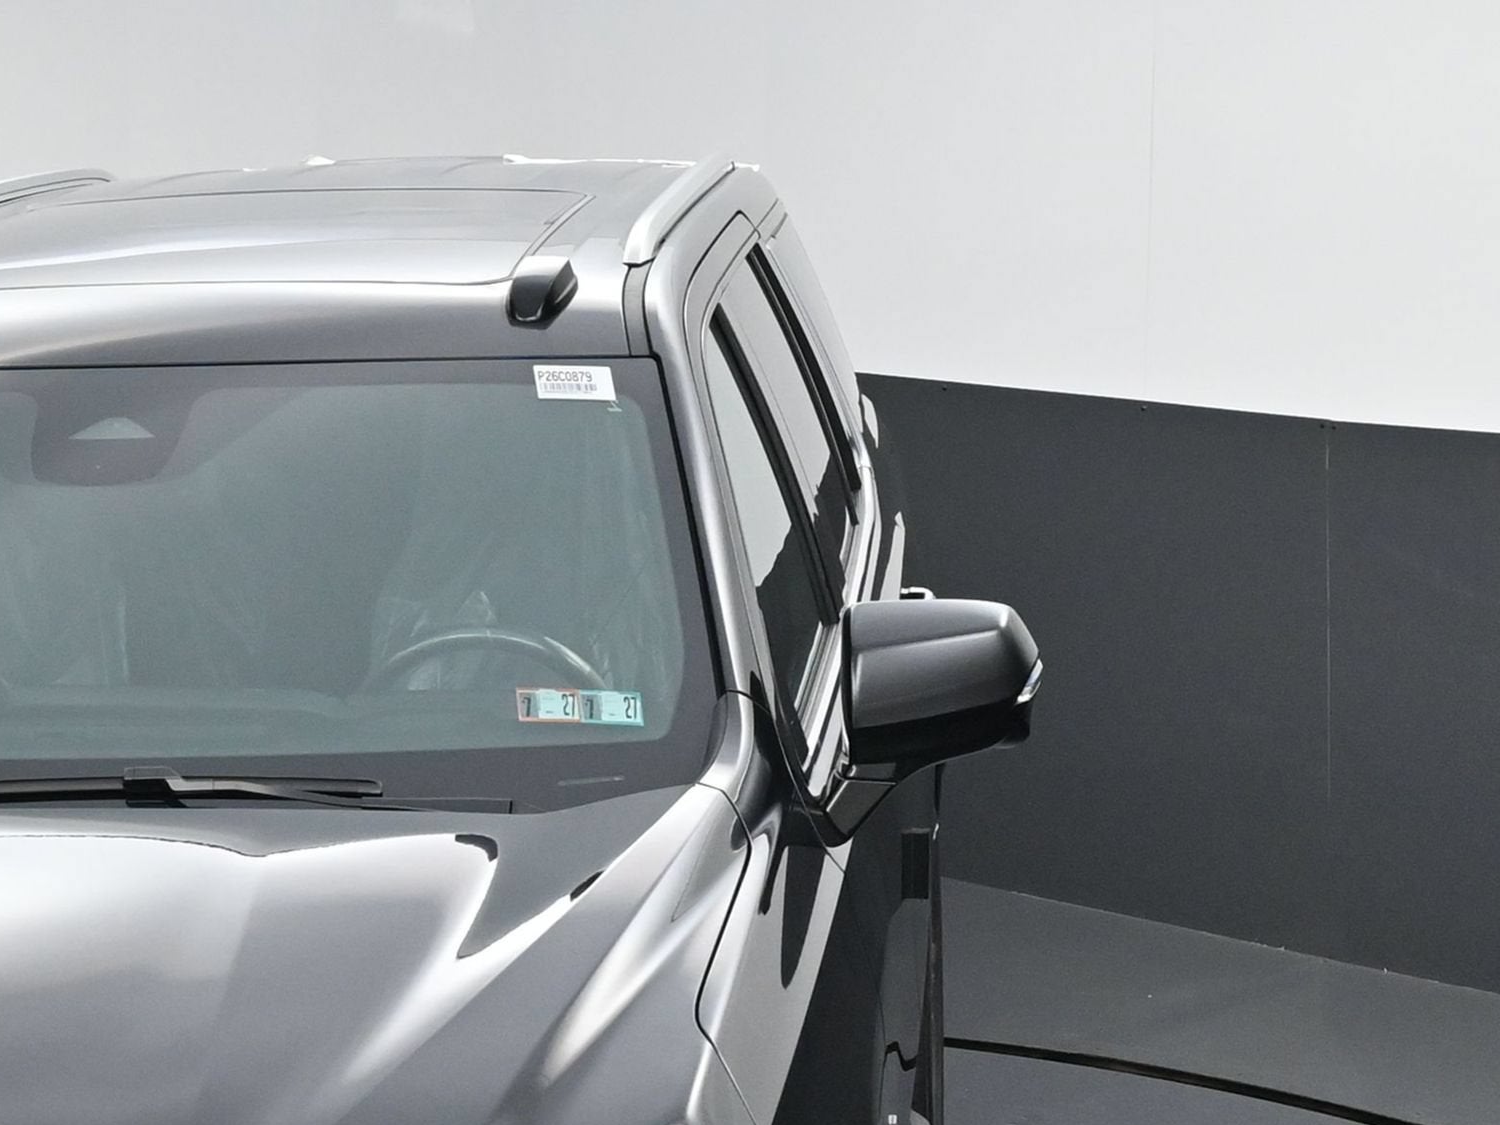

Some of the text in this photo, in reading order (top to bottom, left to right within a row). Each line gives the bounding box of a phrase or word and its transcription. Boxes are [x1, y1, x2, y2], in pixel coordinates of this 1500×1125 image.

[537, 370, 593, 382] P26C0879
[561, 693, 576, 717] 27
[623, 696, 637, 719] 27
